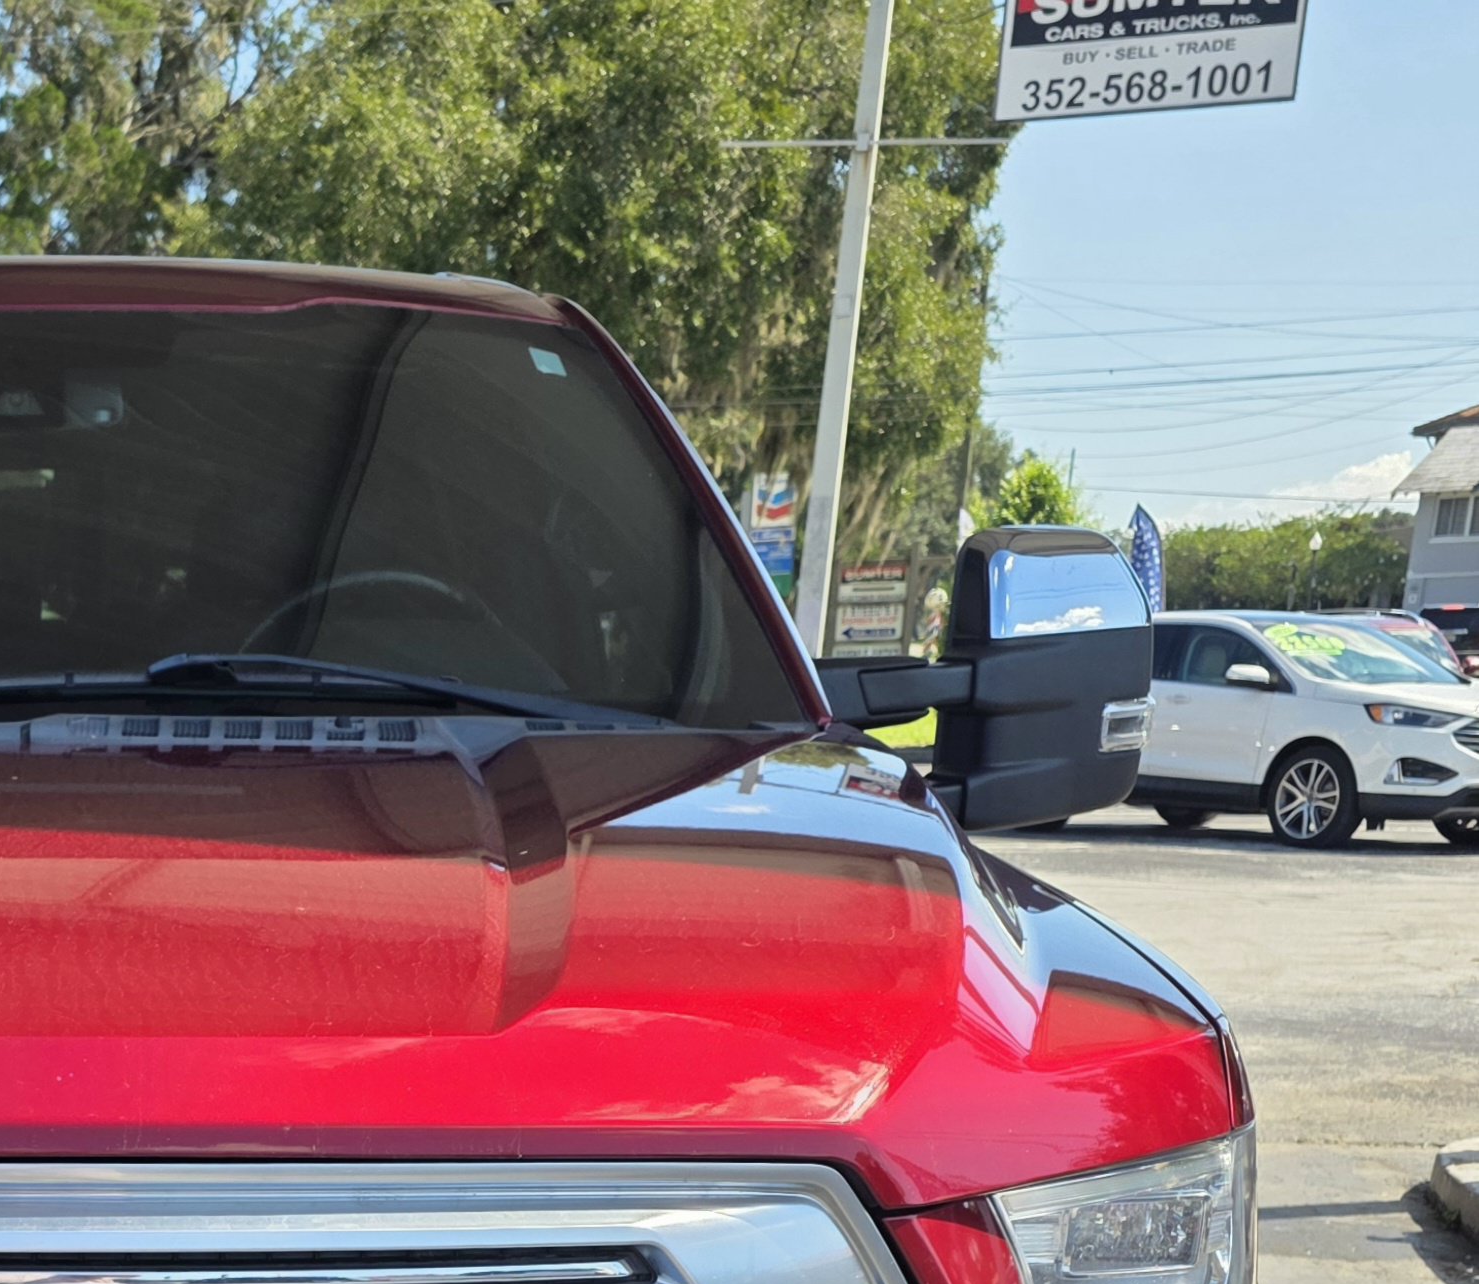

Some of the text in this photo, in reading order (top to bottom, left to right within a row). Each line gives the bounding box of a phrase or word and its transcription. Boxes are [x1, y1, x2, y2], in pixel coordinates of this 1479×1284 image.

[1044, 25, 1104, 42] CARS
[1109, 20, 1127, 37] &
[1229, 13, 1261, 26] Inc.
[1062, 37, 1236, 65] BUY SELL TRADE
[1021, 60, 1274, 113] 352-568-1001
